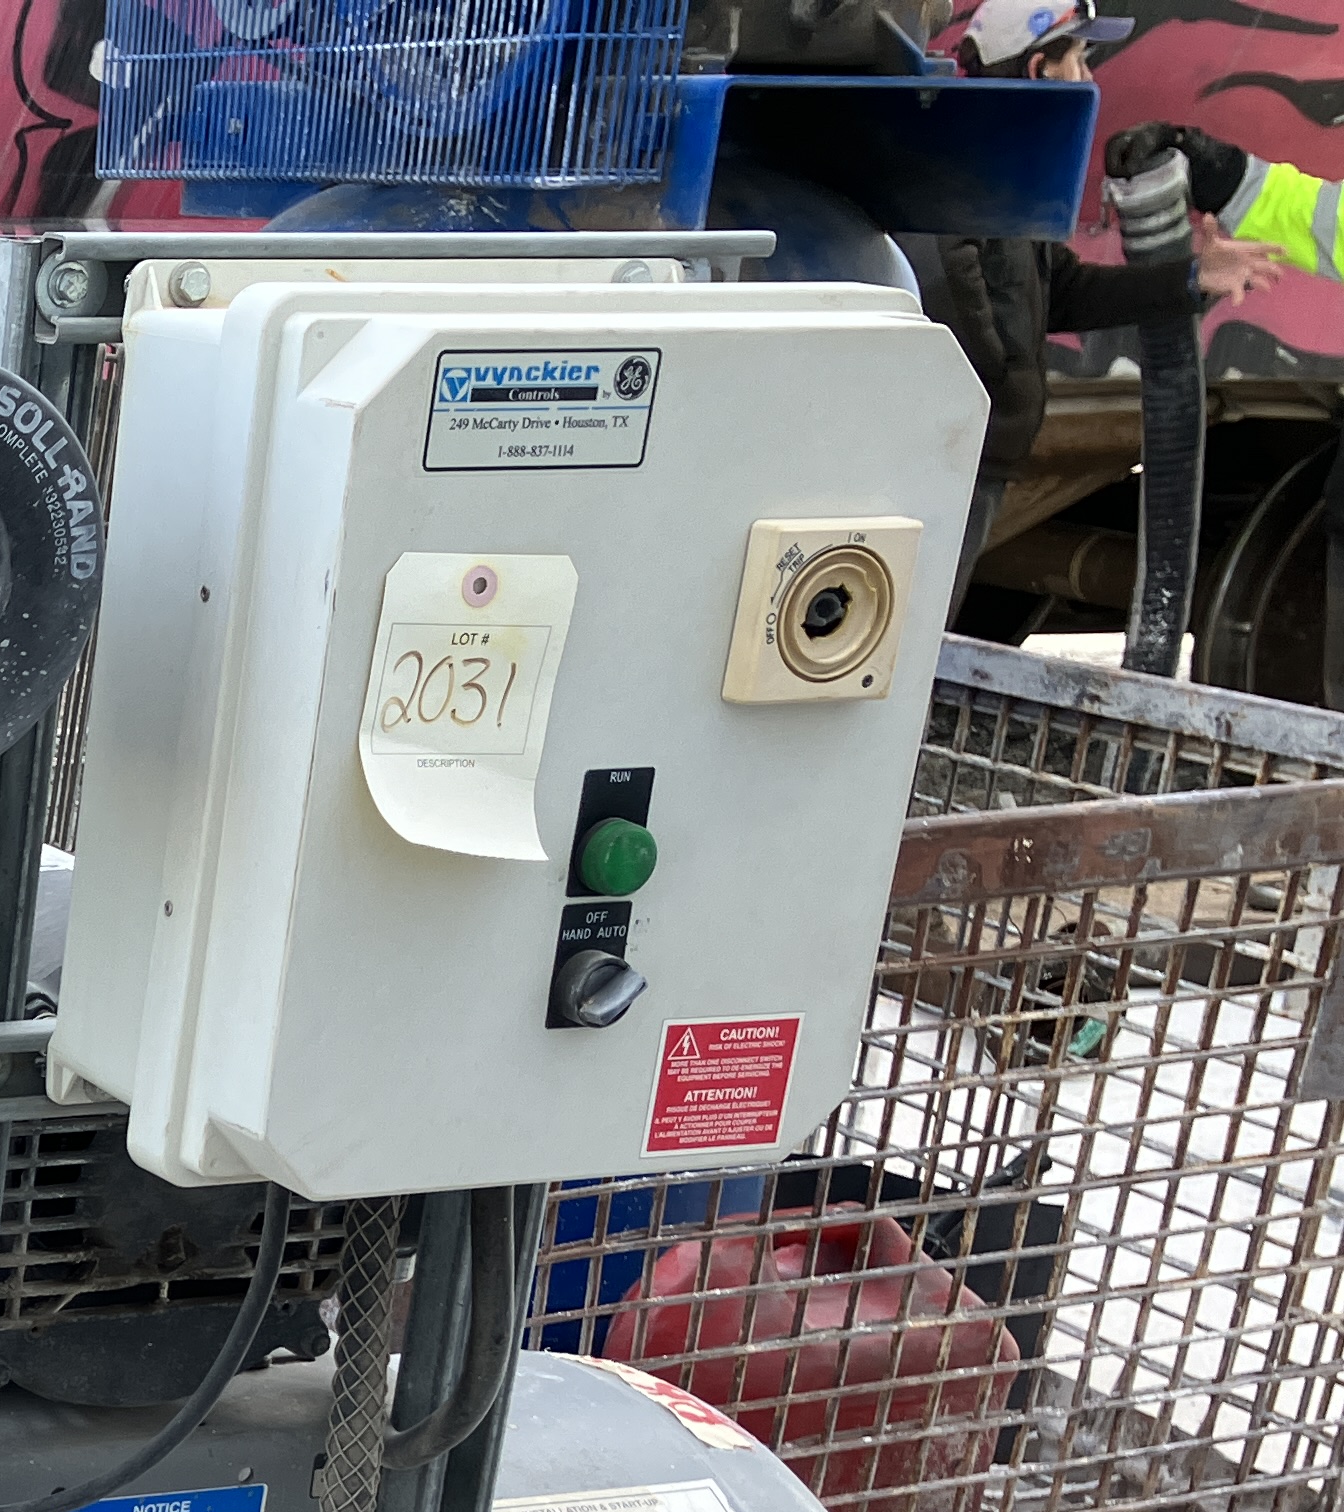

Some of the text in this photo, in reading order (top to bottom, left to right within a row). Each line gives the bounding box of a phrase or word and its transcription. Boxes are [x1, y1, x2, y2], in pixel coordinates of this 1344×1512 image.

[473, 361, 601, 386] vynckier
[508, 387, 612, 401] Controls by
[449, 415, 629, 432] 249 McCarty Drive Houston, TX
[498, 444, 574, 458] 1-888-837-1114
[776, 542, 802, 571] RESET
[787, 553, 805, 573] TRIP
[451, 633, 490, 646] LOT #
[765, 627, 775, 645] OFF
[380, 650, 517, 734] 2031
[417, 759, 475, 768] DESCRIPTION
[609, 771, 631, 783] RUN
[585, 911, 609, 924] OFF
[562, 925, 627, 940] HAND AUTO
[720, 1026, 780, 1041] CAUTION!
[684, 1086, 758, 1102] ATTENTION!
[610, 1497, 660, 1511] START-UP
